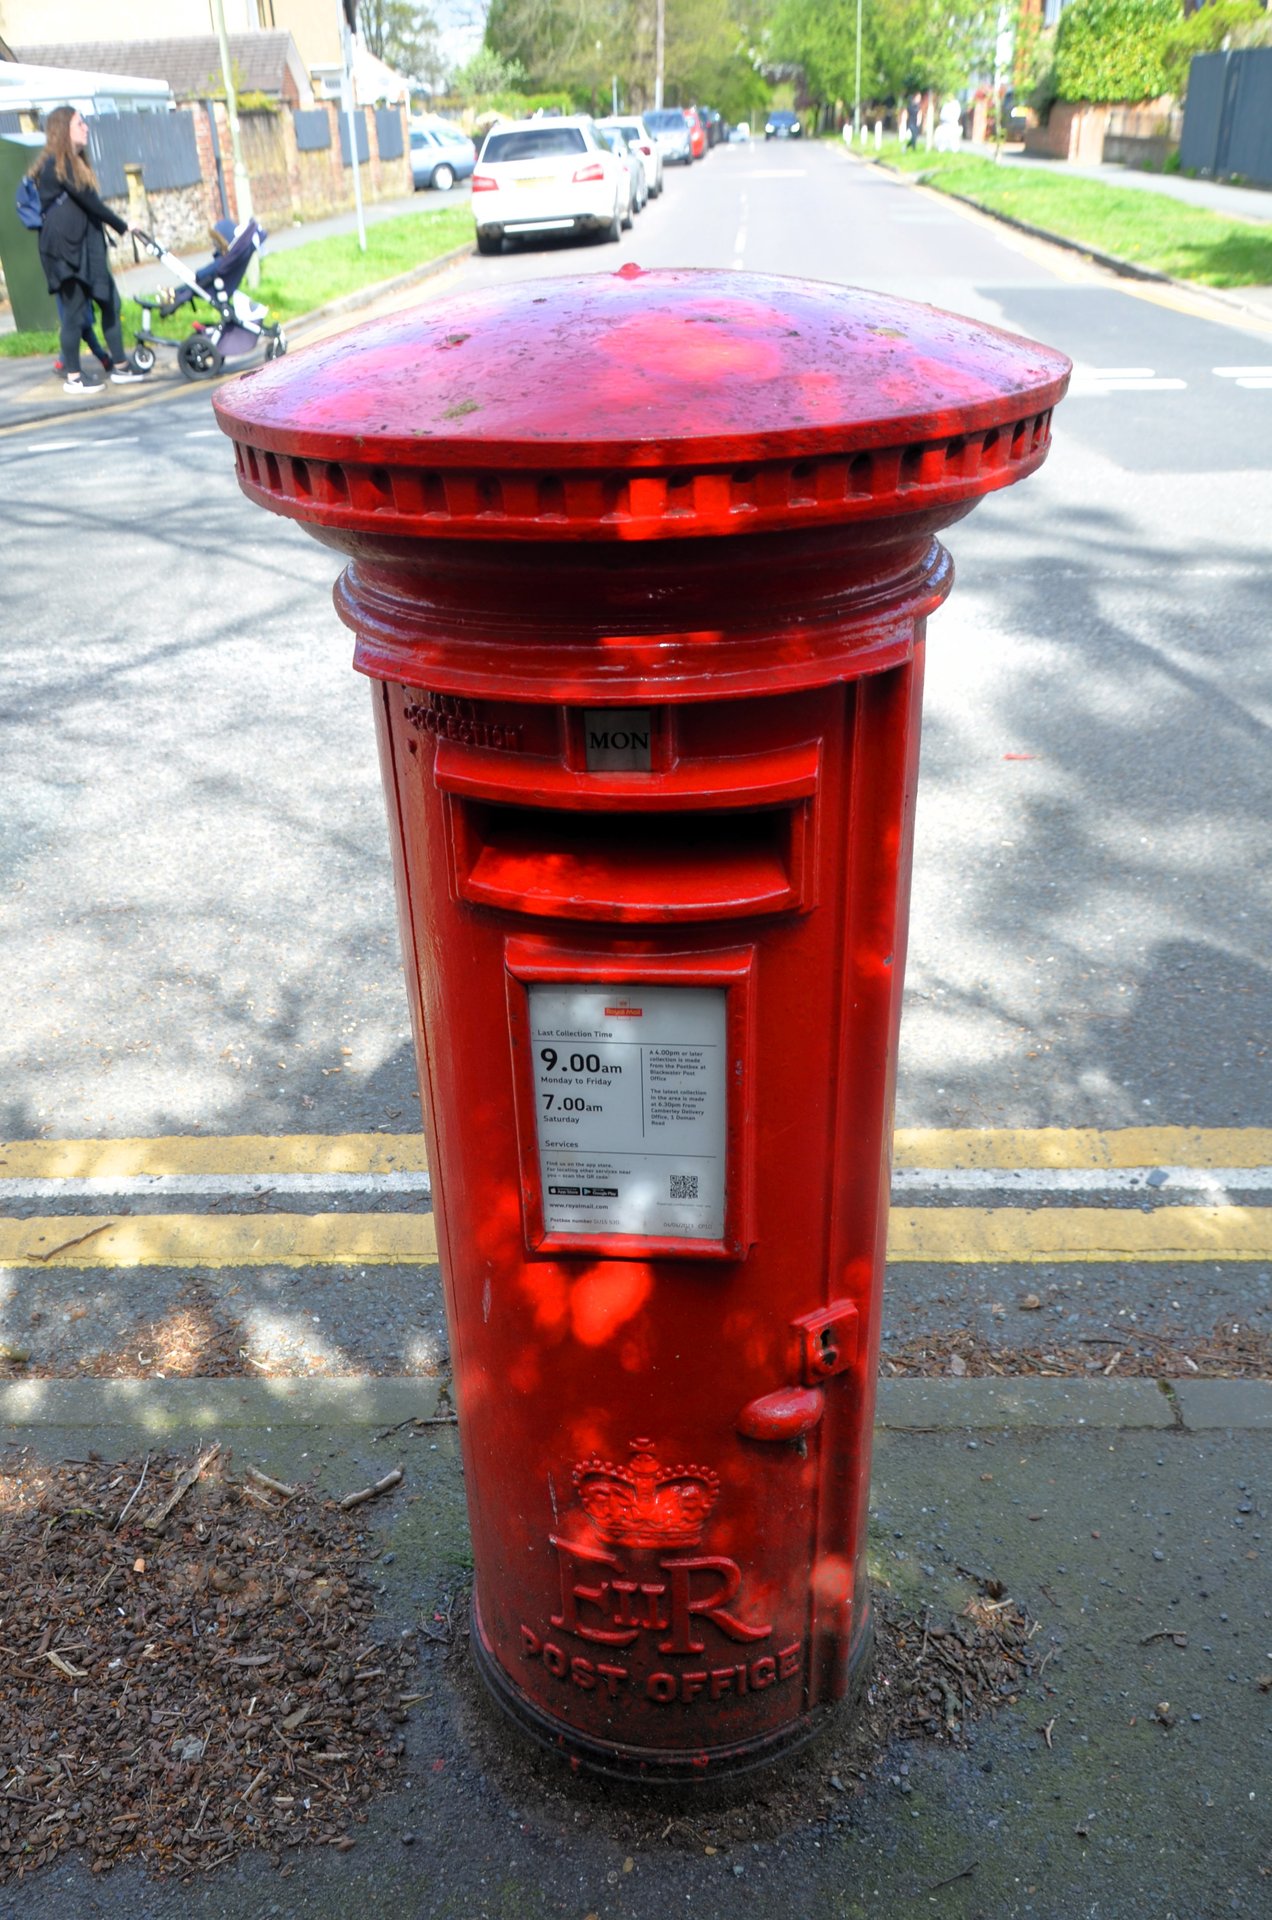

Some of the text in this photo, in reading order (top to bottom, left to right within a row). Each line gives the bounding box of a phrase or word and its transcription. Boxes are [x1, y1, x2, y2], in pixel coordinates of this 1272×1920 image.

[589, 732, 649, 750] MON
[540, 1048, 622, 1074] 9.00am
[540, 1076, 572, 1086] Monday
[586, 1078, 612, 1086] Friday
[542, 1094, 603, 1112] 7.00am
[543, 1115, 580, 1124] Saturday
[545, 1140, 579, 1148] Services
[520, 1624, 801, 1703] POST OFFICE
